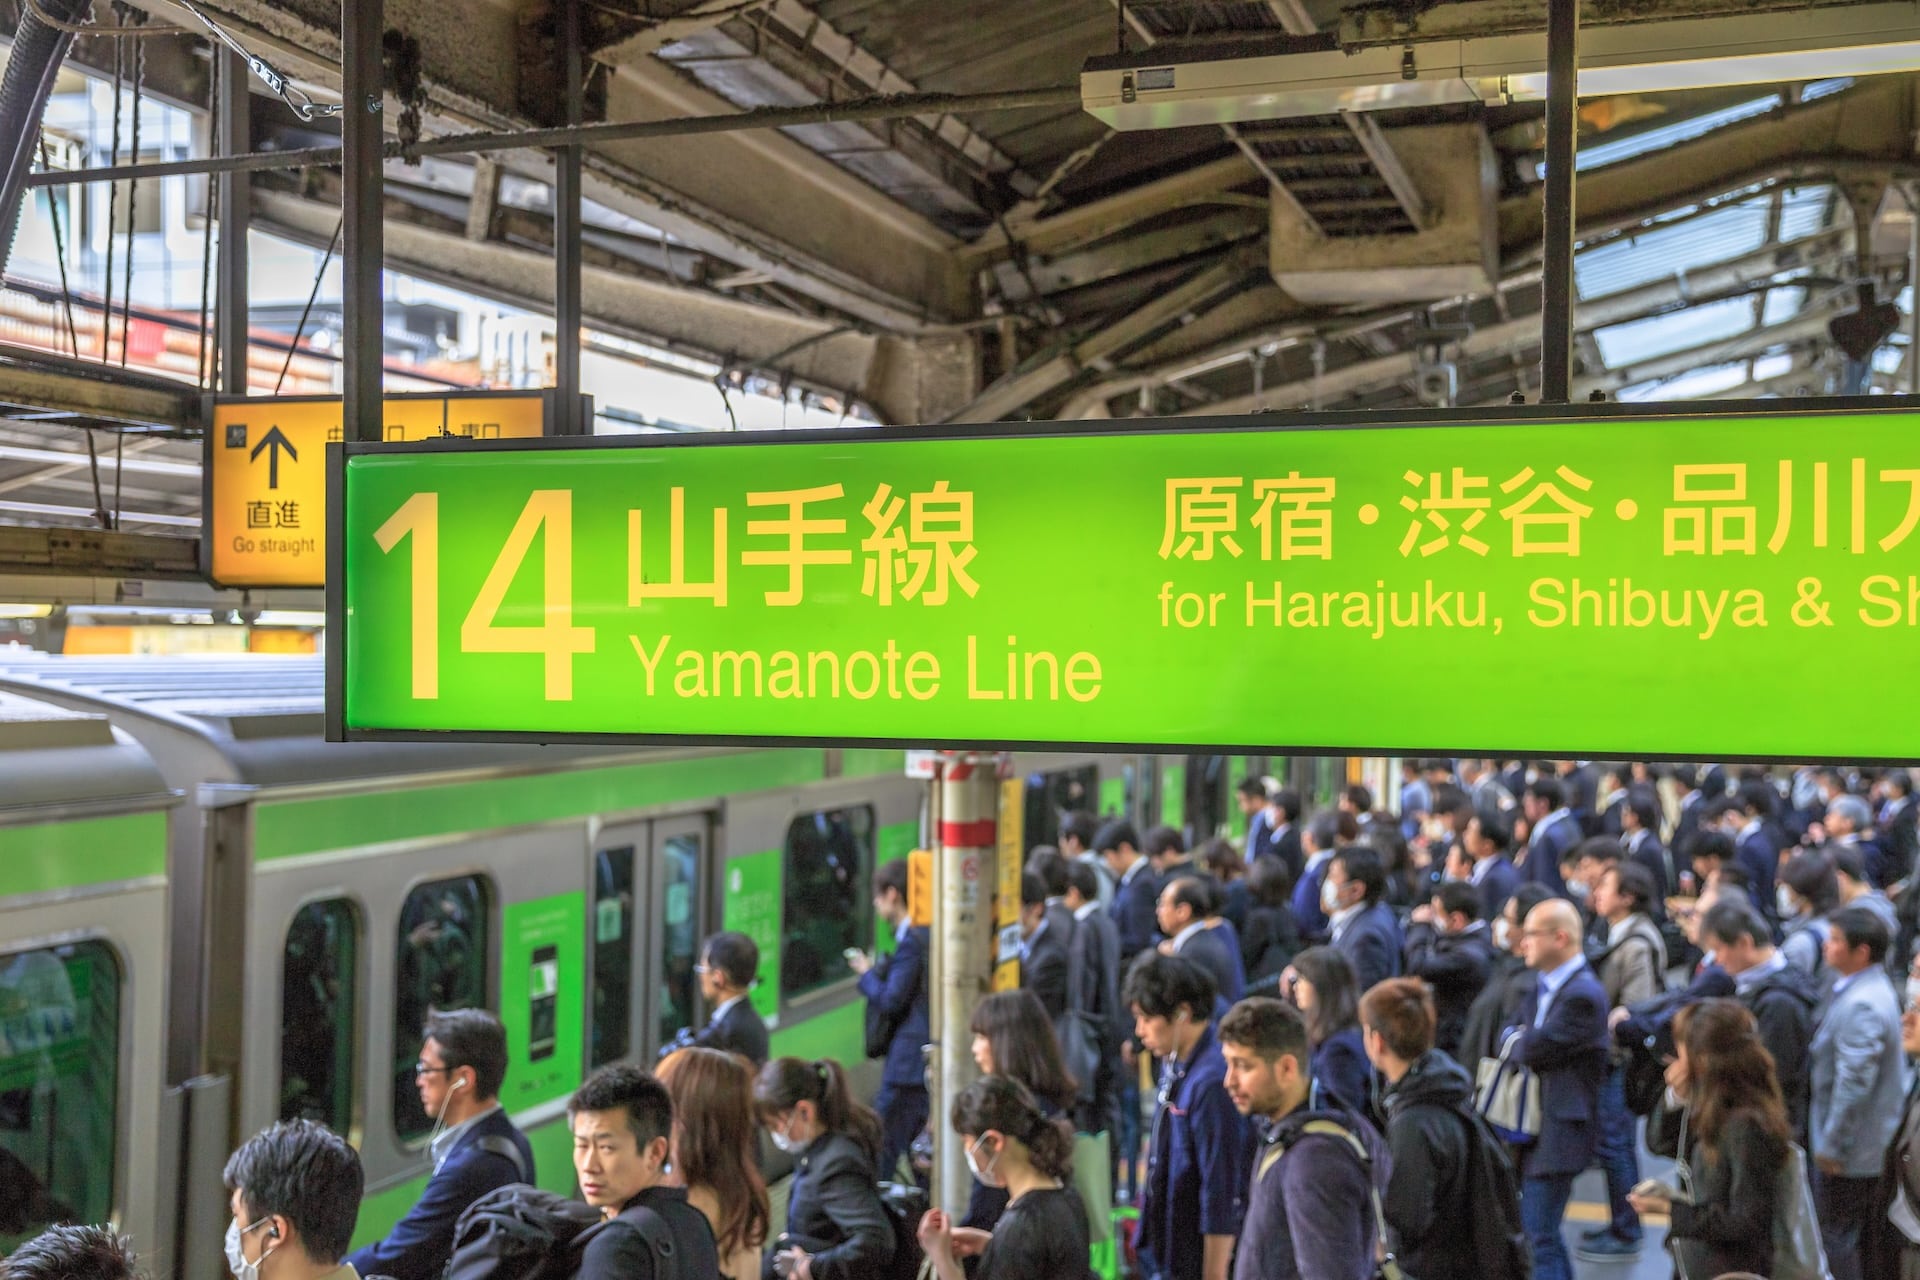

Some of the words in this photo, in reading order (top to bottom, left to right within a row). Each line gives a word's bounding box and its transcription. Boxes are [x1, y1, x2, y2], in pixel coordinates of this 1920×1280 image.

[246, 500, 300, 528] 直進
[628, 481, 980, 607] 山手線
[233, 536, 255, 553] Go
[260, 538, 315, 557] straight
[373, 489, 596, 701] 14
[1158, 582, 1226, 627] for
[1246, 580, 1503, 639] Harajuku,
[1528, 578, 1768, 639] Shibuya
[1790, 577, 1834, 627] &
[629, 635, 941, 700] Yamanote
[968, 635, 1102, 702] Line
